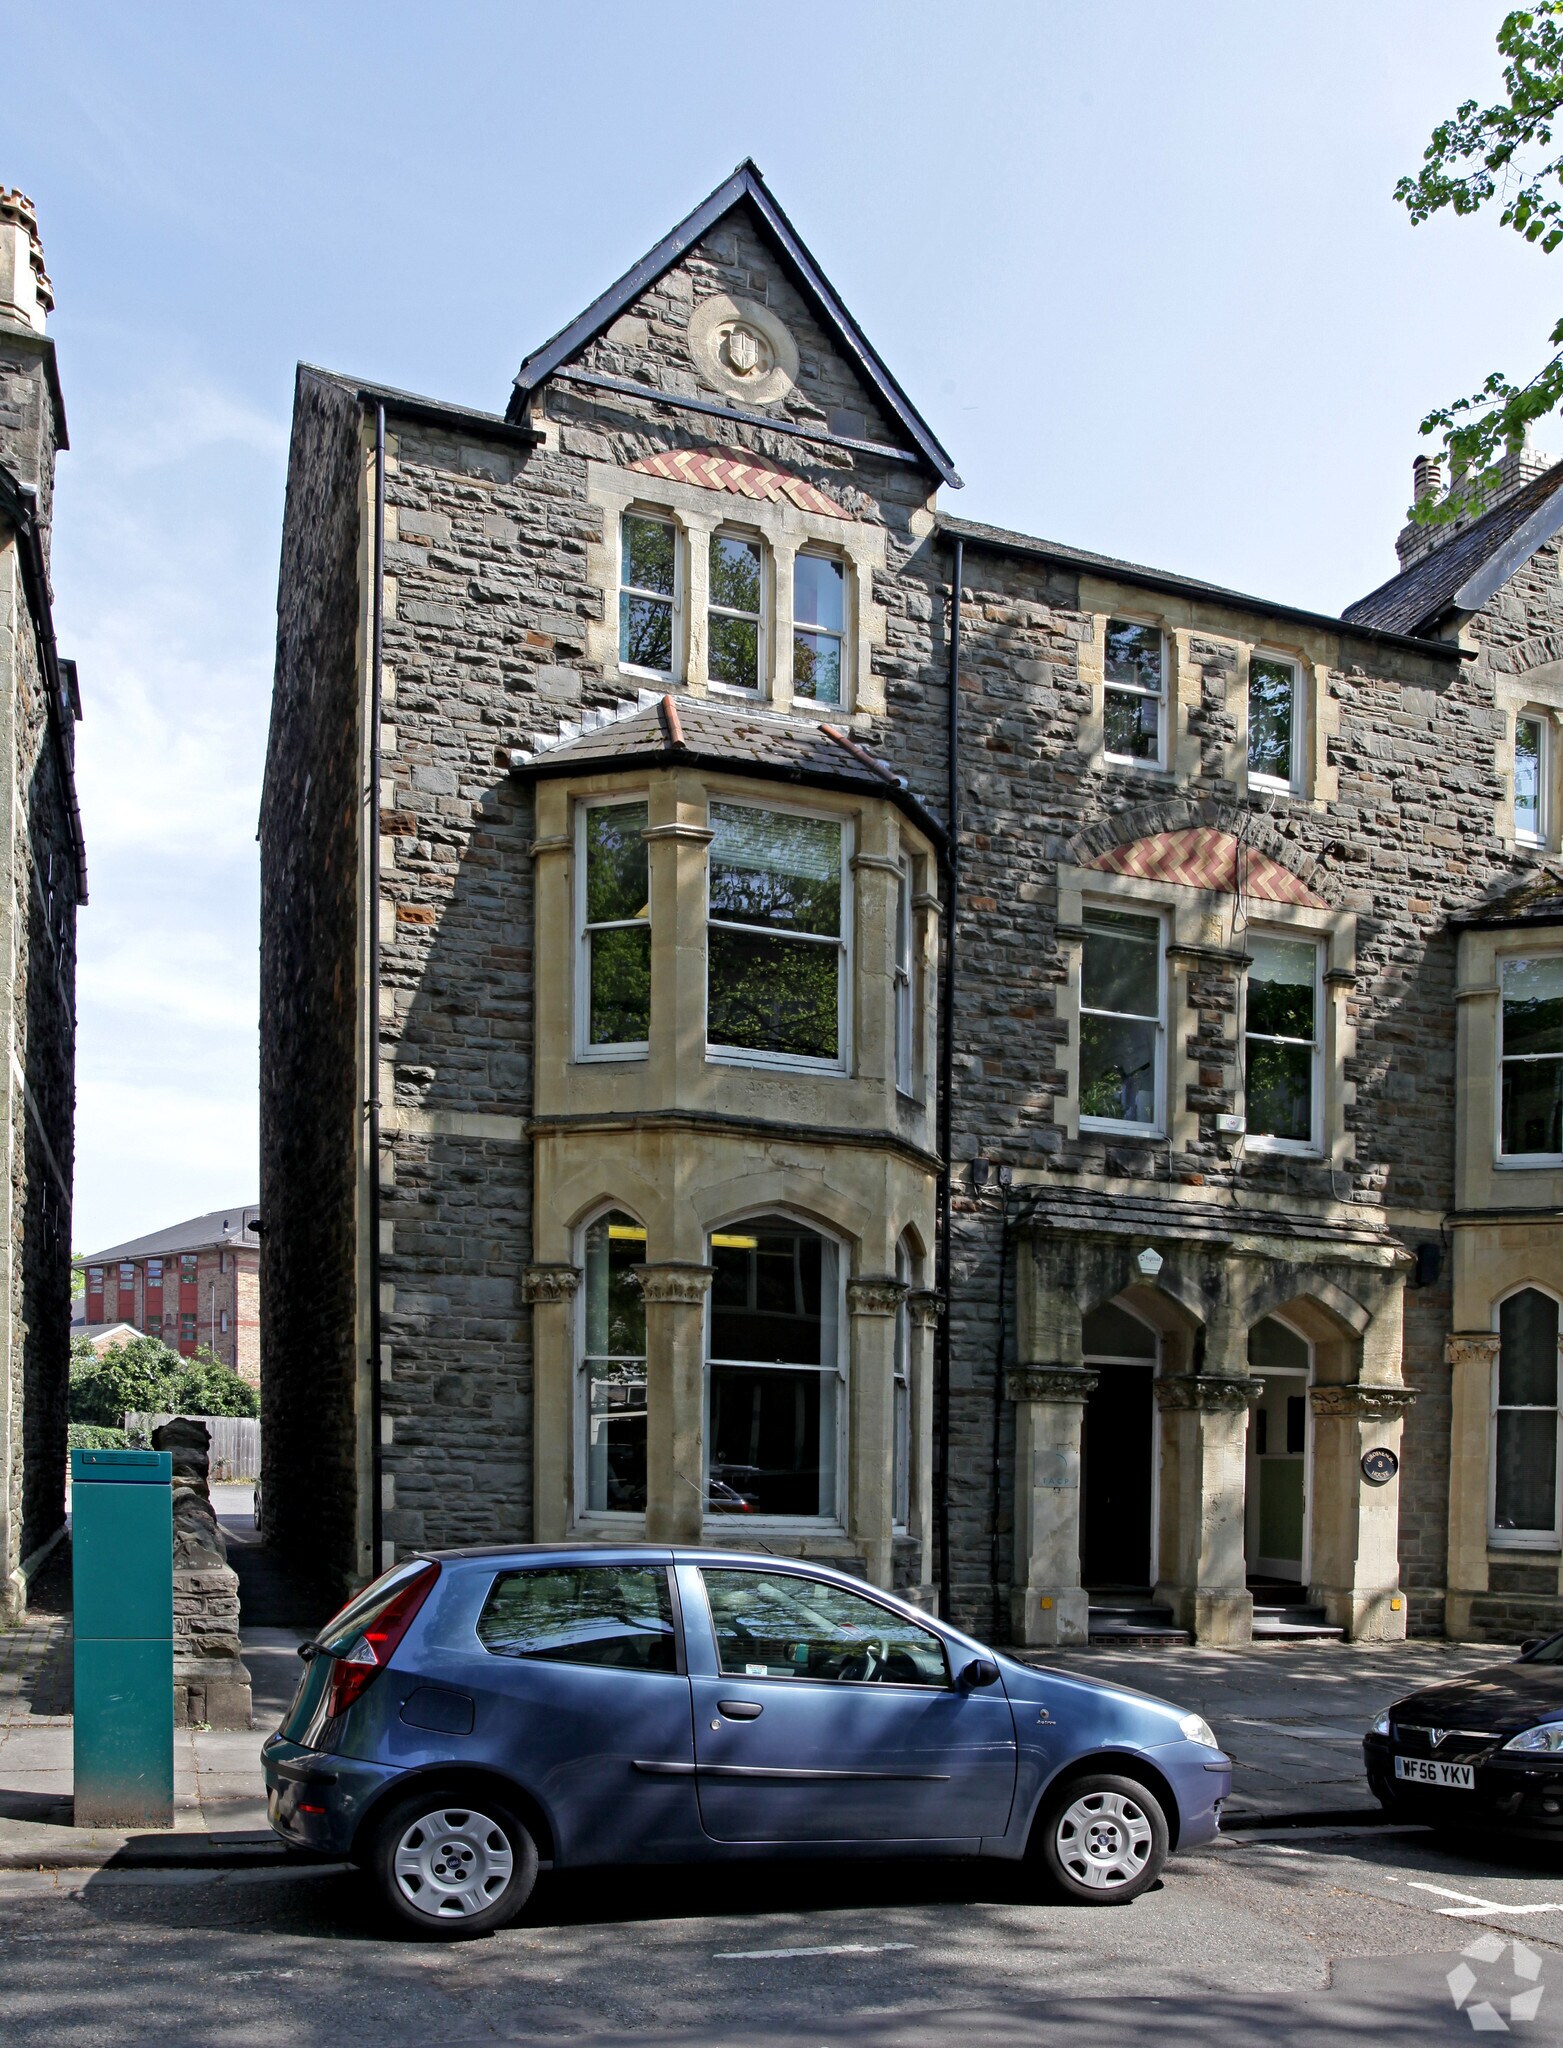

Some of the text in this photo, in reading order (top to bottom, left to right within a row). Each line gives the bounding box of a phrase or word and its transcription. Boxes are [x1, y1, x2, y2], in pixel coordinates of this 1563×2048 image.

[1377, 1460, 1383, 1468] 8
[1371, 1470, 1390, 1478] HOUSE
[1402, 1759, 1471, 1785] WF56 YKV
